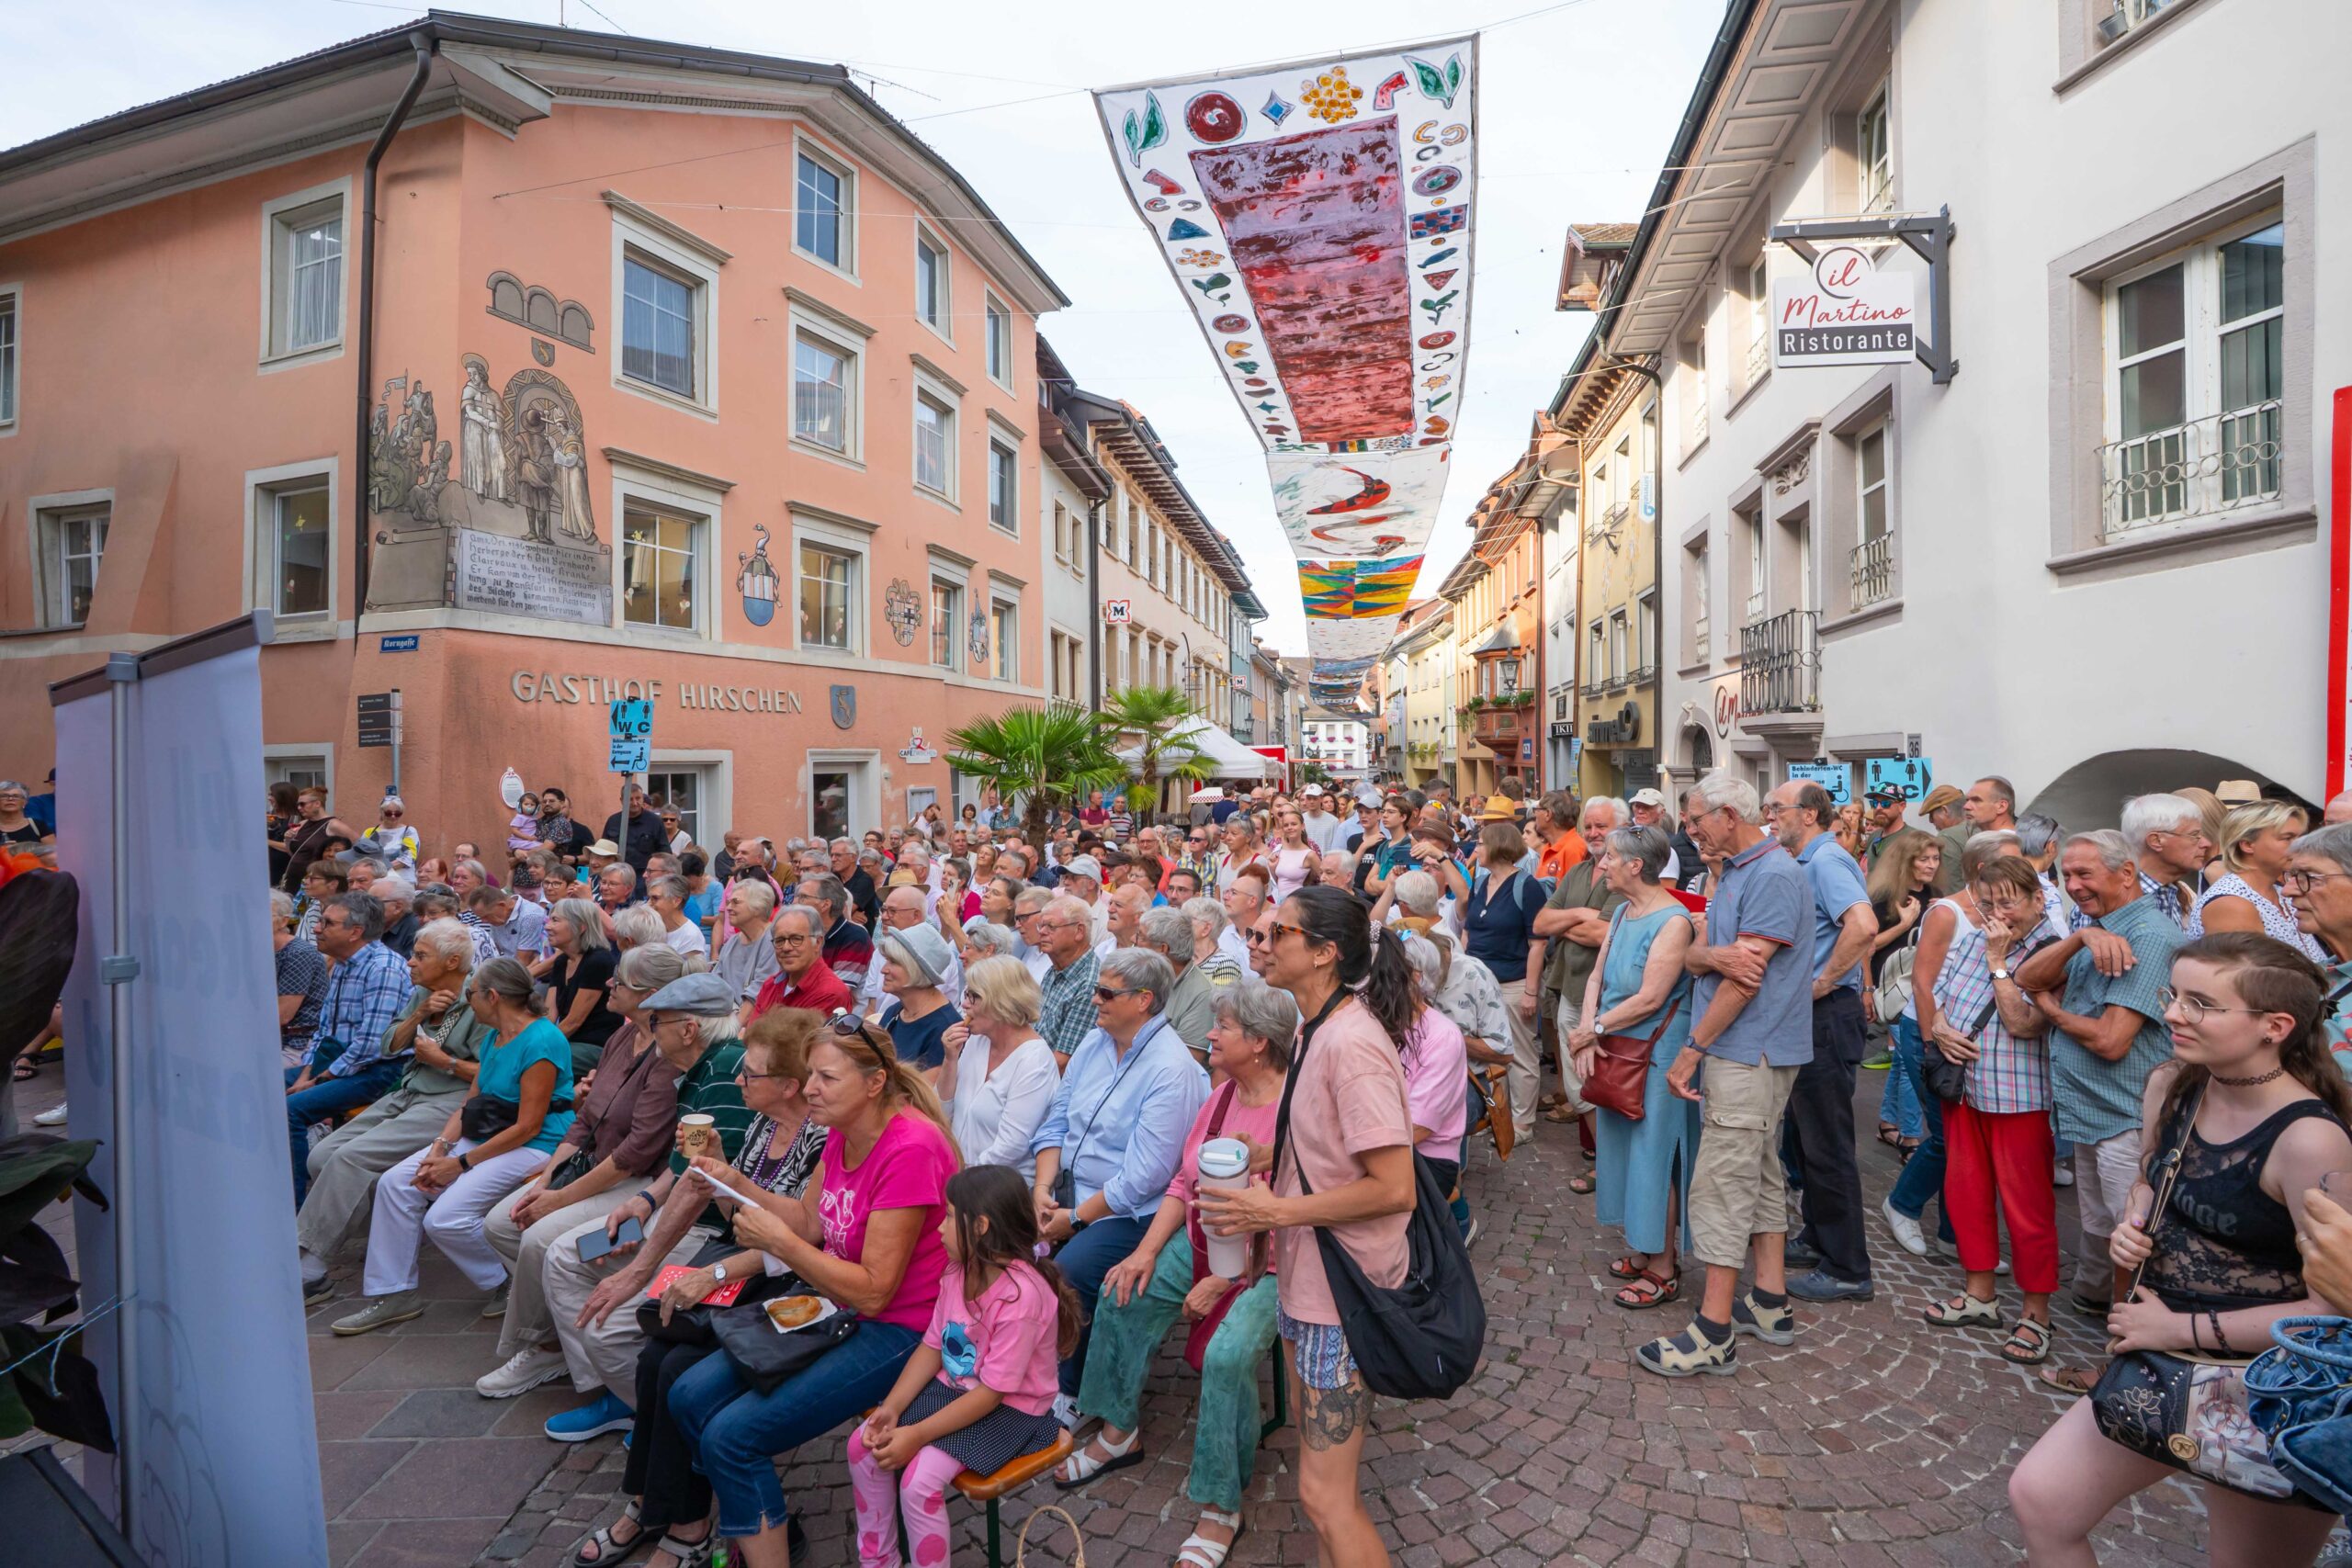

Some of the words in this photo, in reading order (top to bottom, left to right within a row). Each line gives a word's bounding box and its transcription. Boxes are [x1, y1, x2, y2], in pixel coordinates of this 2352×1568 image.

[1828, 257, 1860, 287] il
[1782, 295, 1912, 331] Martino
[1784, 331, 1907, 352] Ristorante
[470, 553, 516, 568] Clairvaux
[470, 564, 481, 573] Er
[469, 583, 481, 593] des
[511, 599, 523, 609] den
[1113, 606, 1125, 616] M
[512, 670, 662, 705] GASTHOF
[680, 683, 802, 714] HIRSCHEN
[1909, 741, 1918, 758] 36
